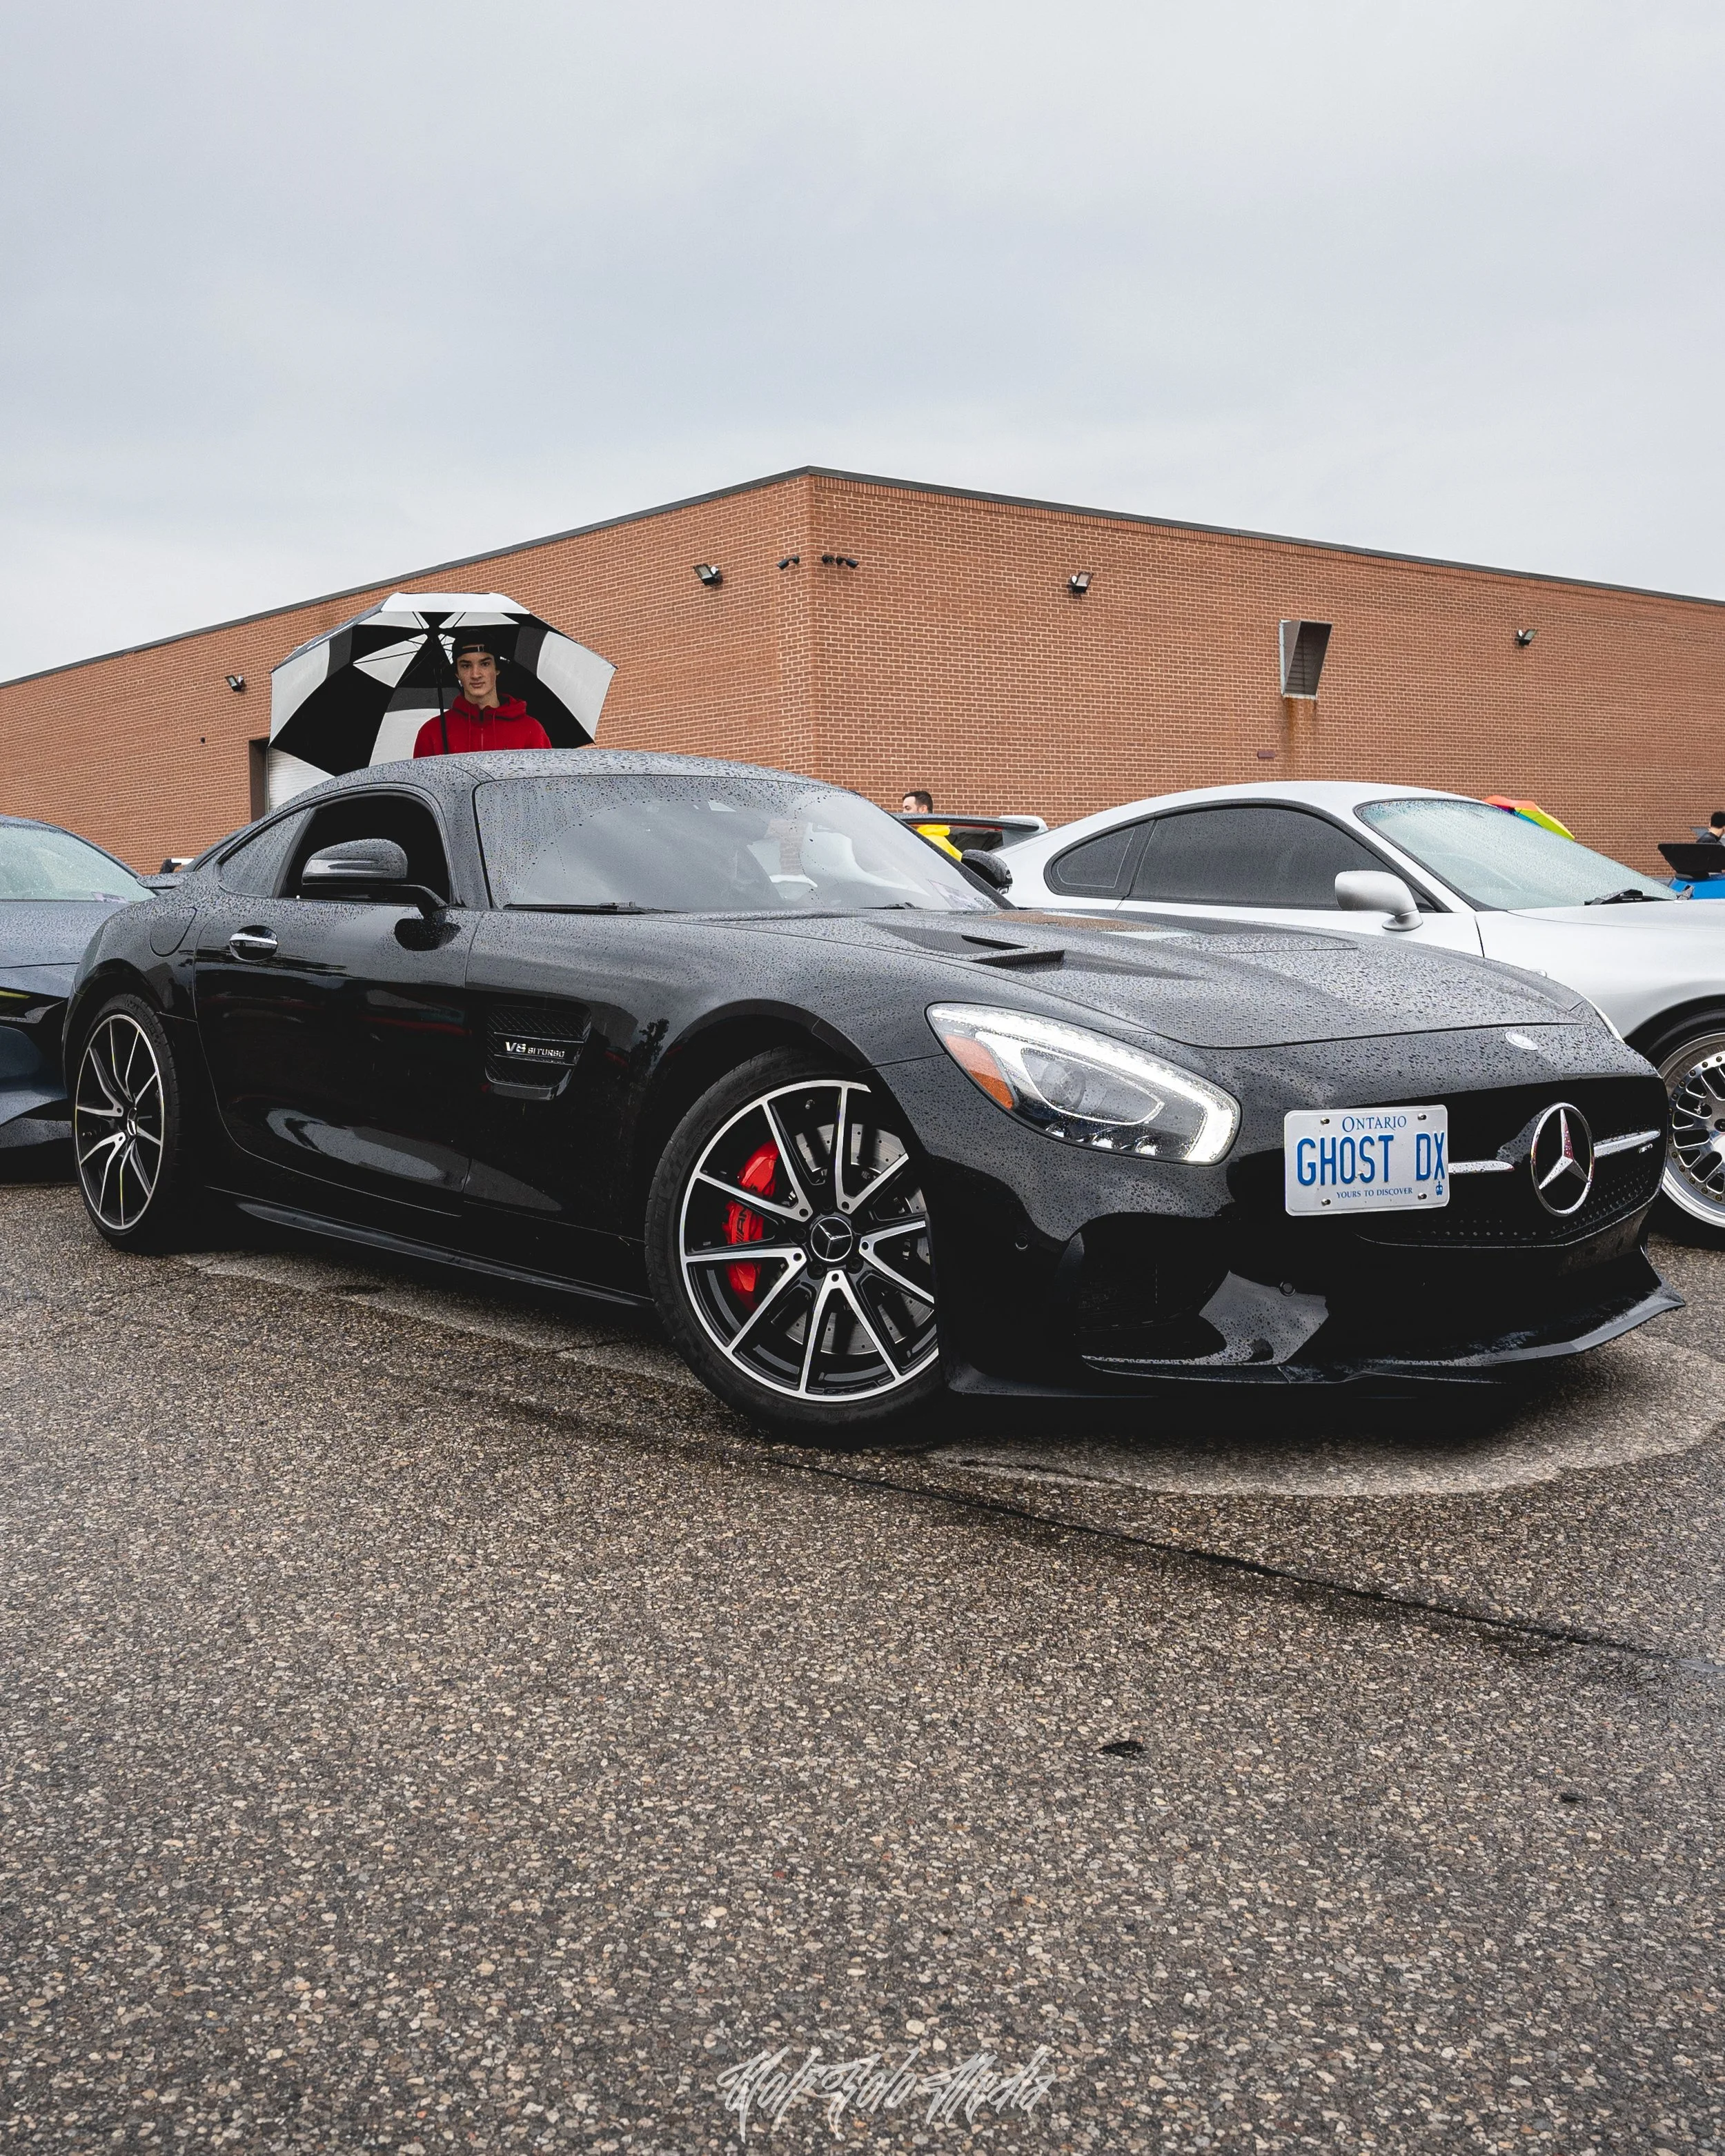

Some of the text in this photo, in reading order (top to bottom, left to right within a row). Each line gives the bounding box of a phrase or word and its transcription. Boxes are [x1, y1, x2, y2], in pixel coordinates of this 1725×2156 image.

[506, 1042, 565, 1058] V8 BITURBO
[1342, 1116, 1407, 1132] ONTARIO
[1297, 1132, 1446, 1186] GHOST DX
[1337, 1190, 1361, 1199] YOURS
[1377, 1187, 1413, 1196] DISCOVER
